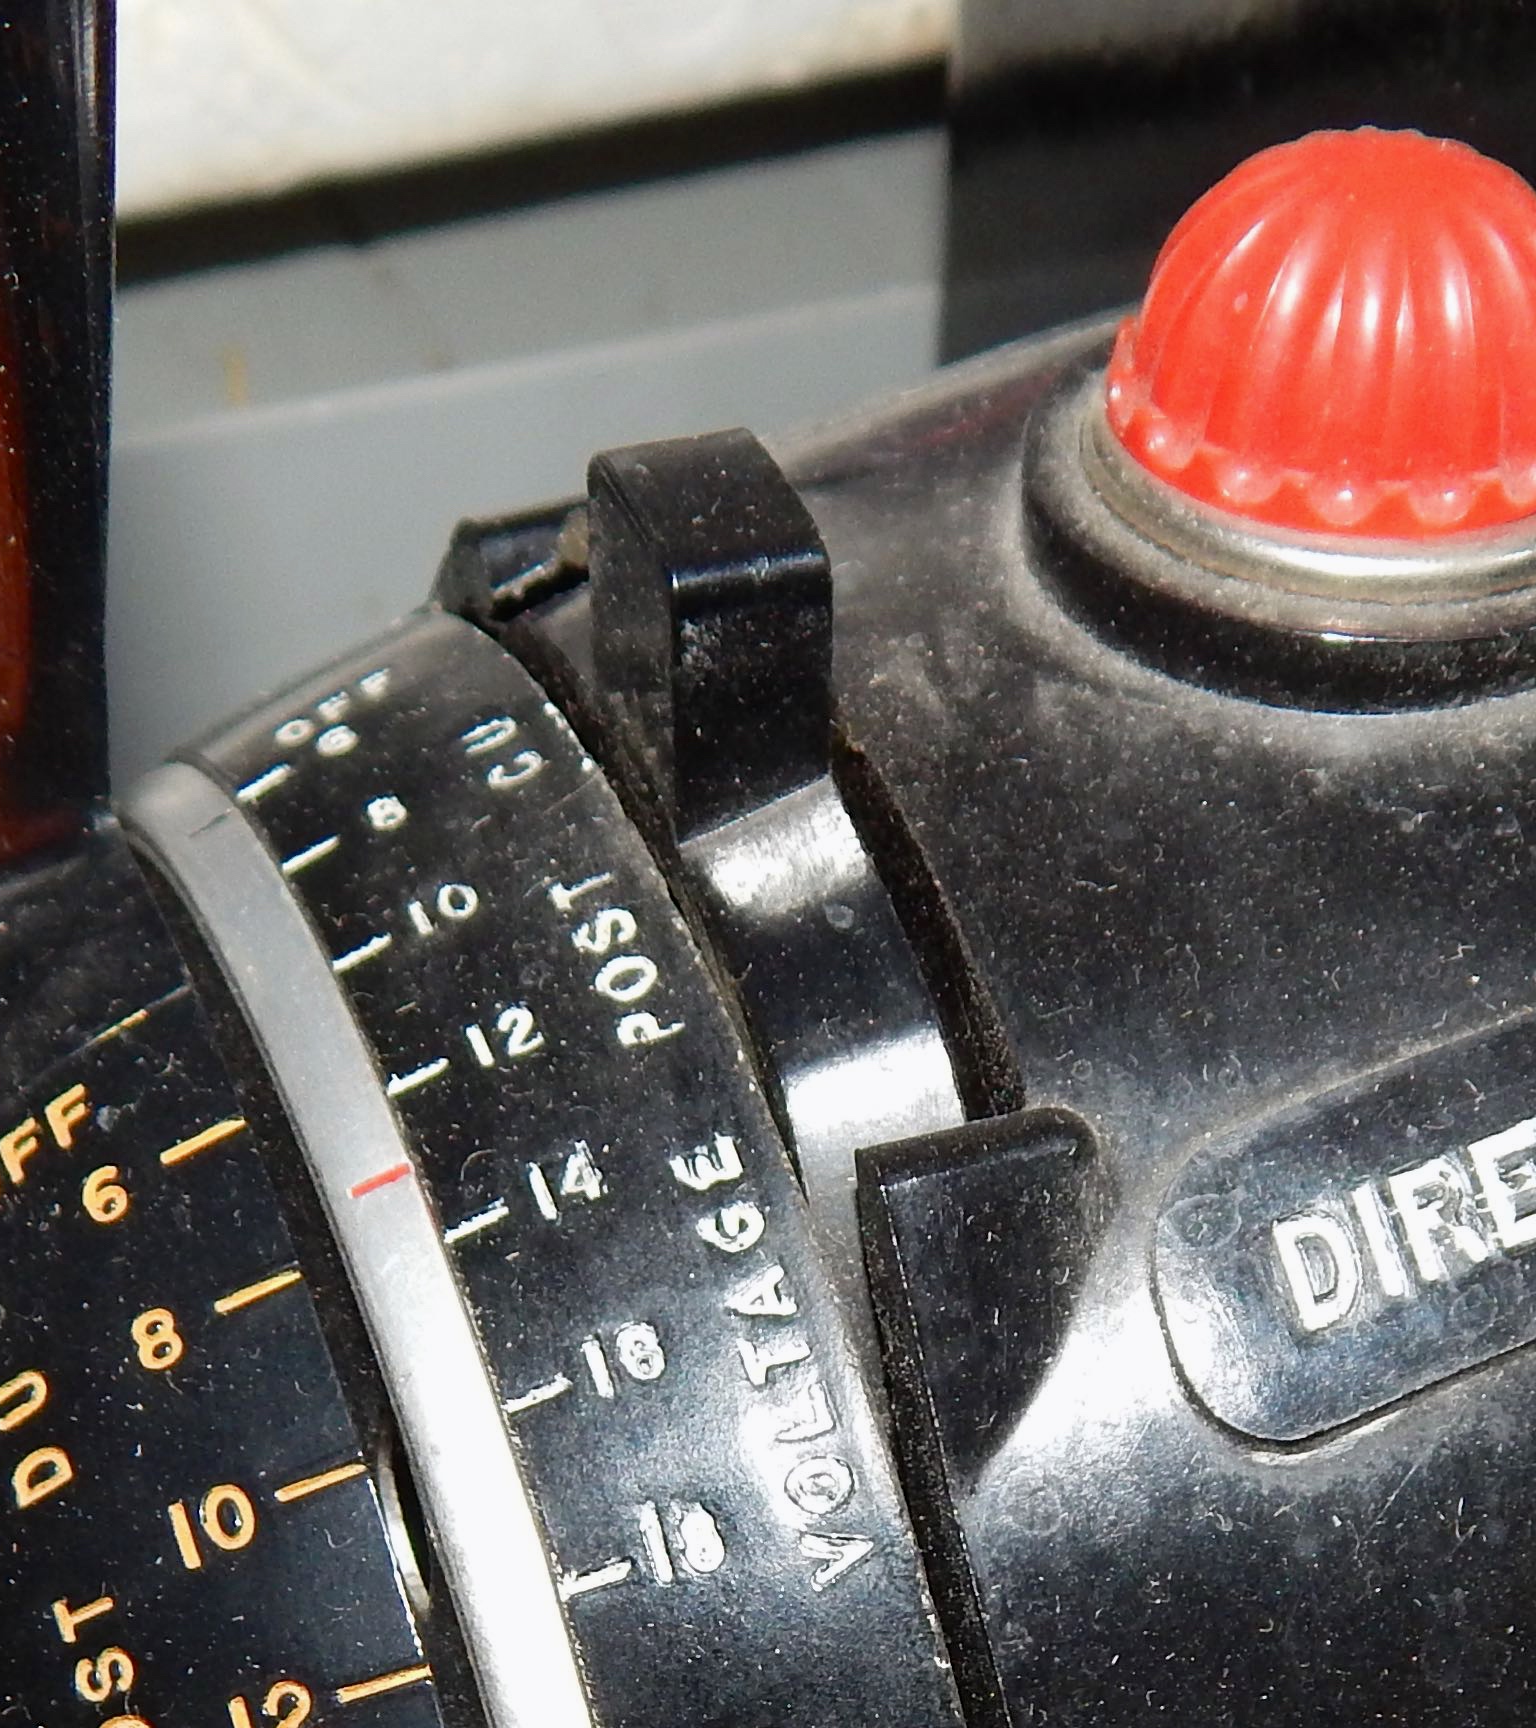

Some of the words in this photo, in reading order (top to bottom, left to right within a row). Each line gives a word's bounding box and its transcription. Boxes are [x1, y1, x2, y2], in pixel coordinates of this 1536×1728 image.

[275, 667, 391, 749] OFF
[316, 725, 360, 758] 6
[461, 716, 545, 791] CU
[366, 795, 408, 832] 8
[408, 883, 478, 936] 10
[548, 871, 686, 1048] POST
[467, 1006, 545, 1067] 12
[82, 1165, 130, 1224] 6
[528, 1139, 609, 1220] 14
[130, 1307, 184, 1371] 8
[670, 1132, 874, 1592] VOLTAGE
[167, 1483, 256, 1570] 10
